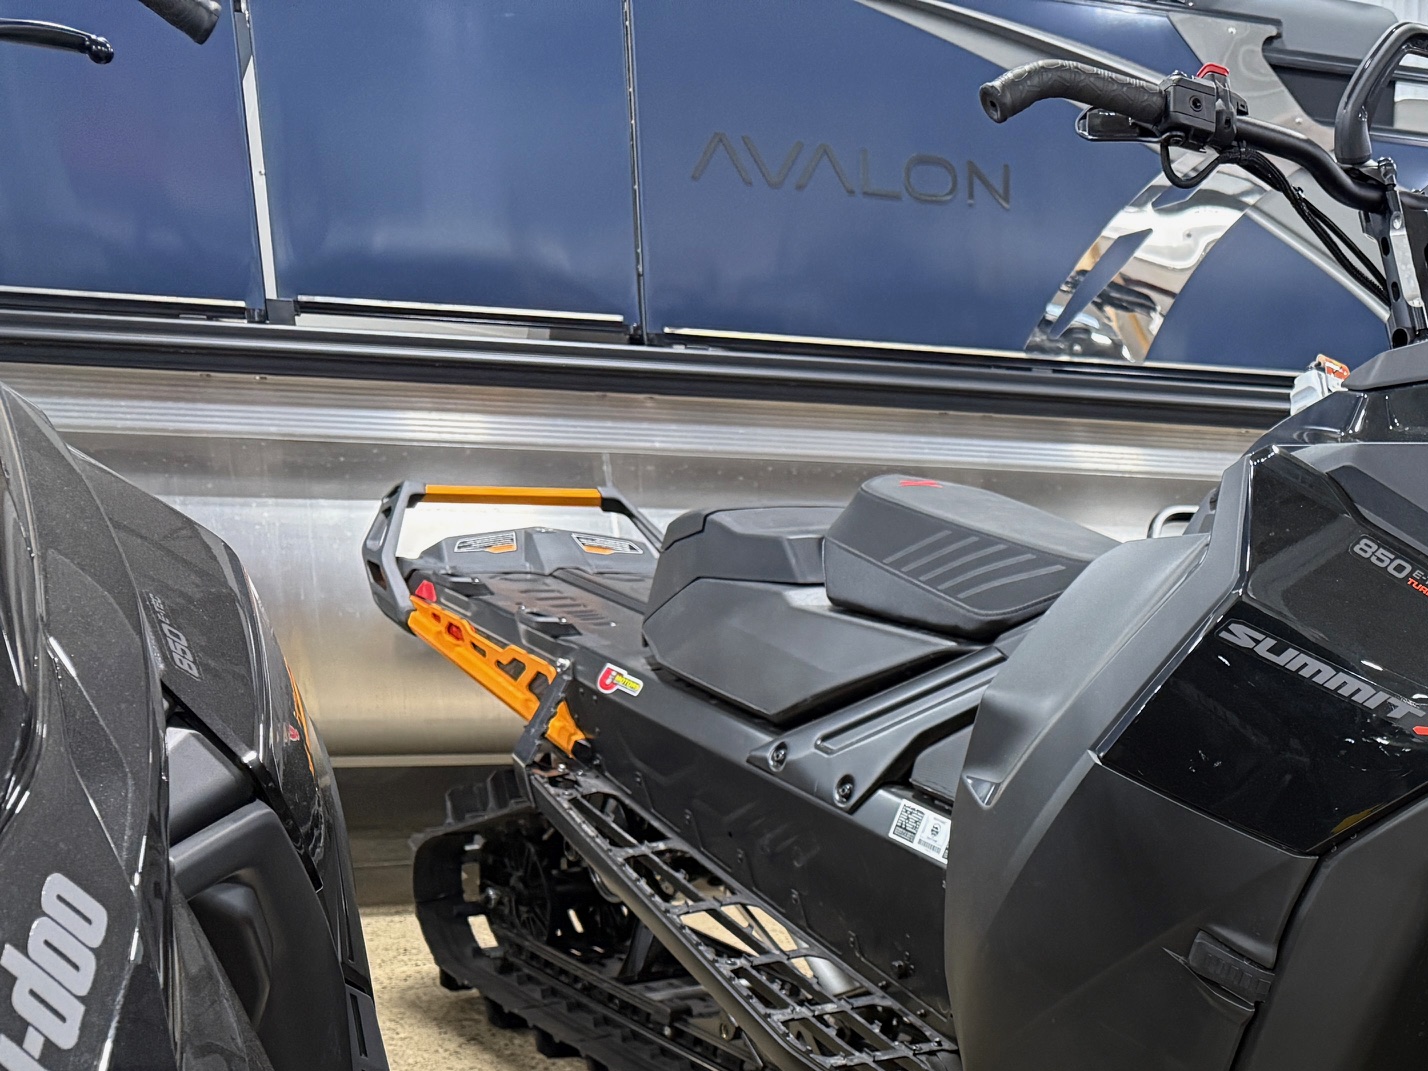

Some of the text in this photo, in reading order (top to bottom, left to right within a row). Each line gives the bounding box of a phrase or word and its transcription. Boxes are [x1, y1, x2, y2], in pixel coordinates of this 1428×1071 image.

[691, 131, 1011, 212] AVALON
[1353, 539, 1412, 579] 850
[161, 622, 200, 678] 850
